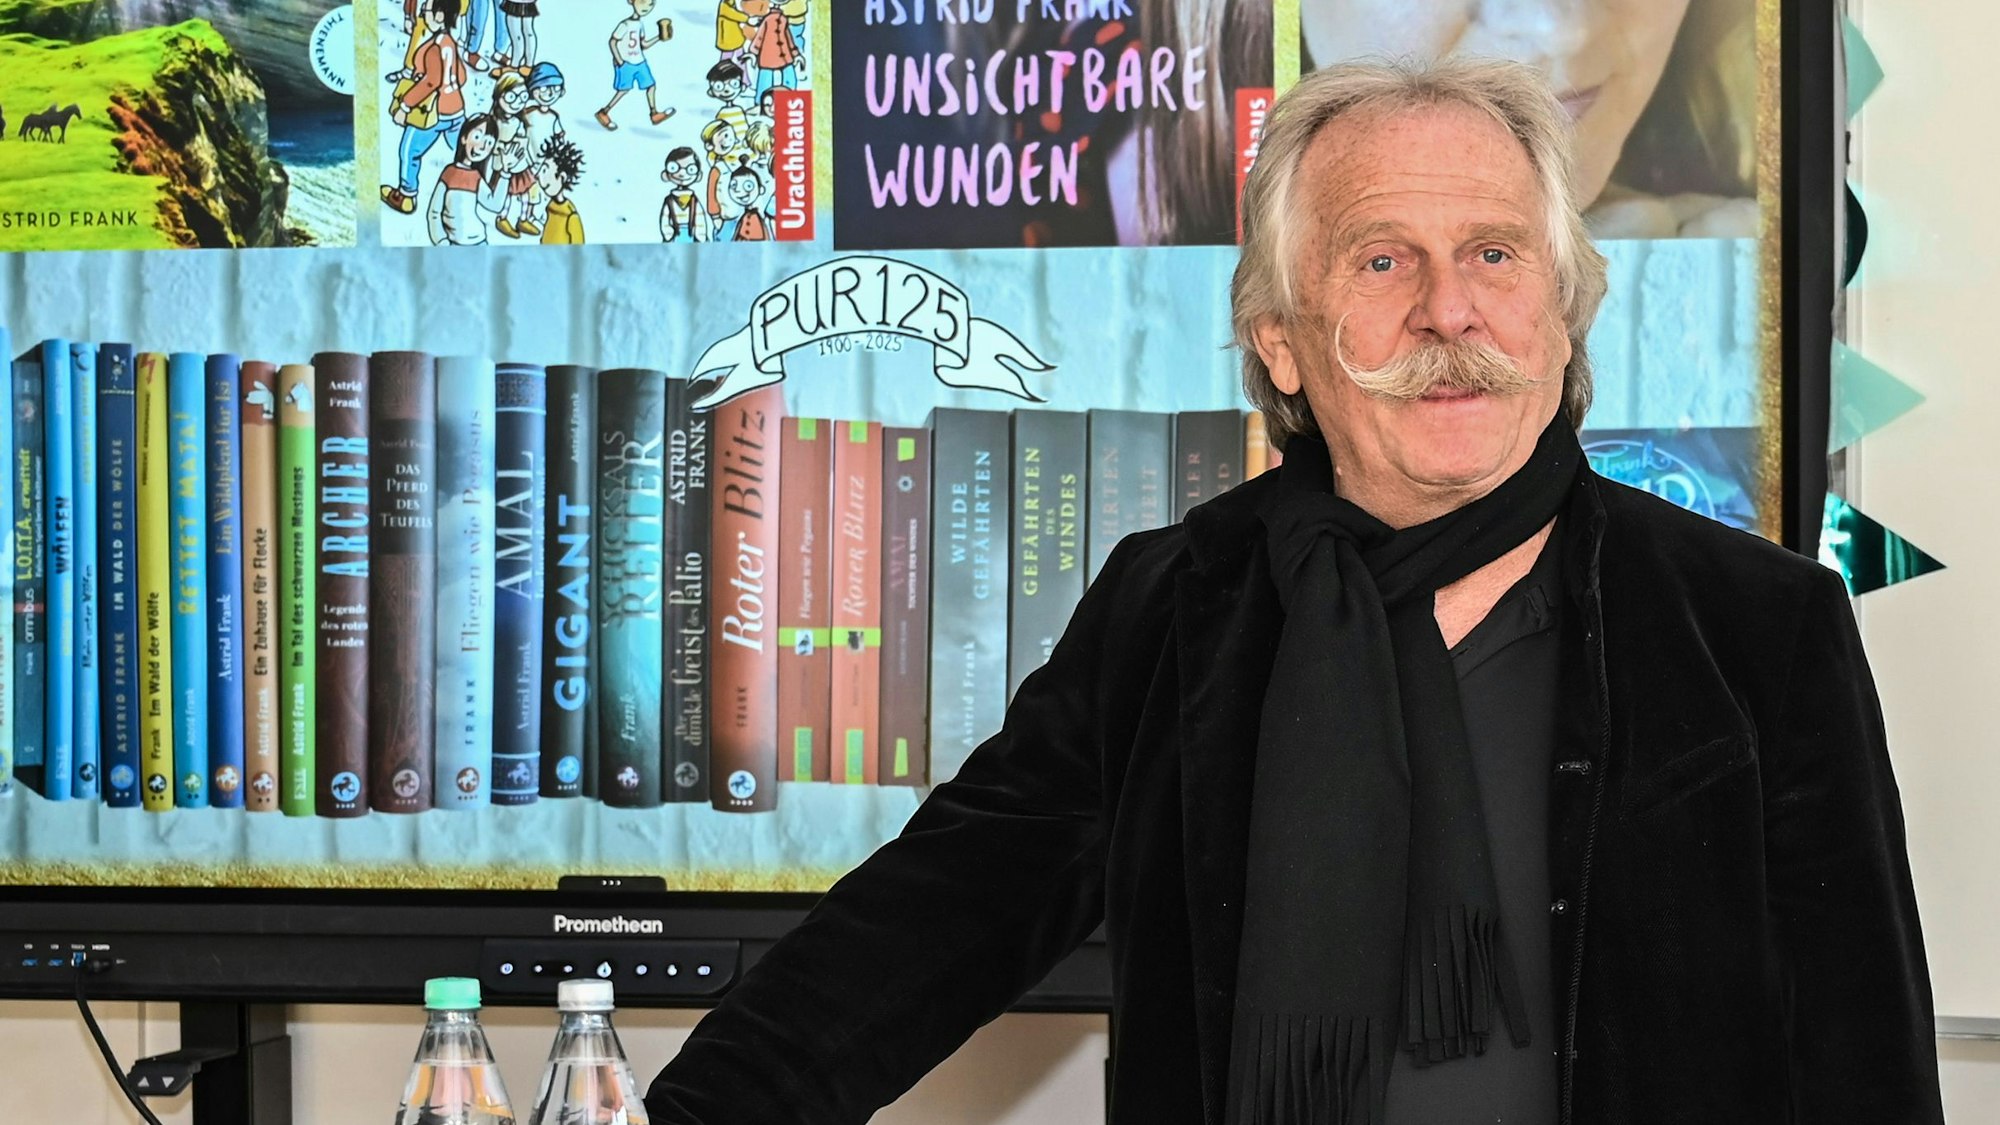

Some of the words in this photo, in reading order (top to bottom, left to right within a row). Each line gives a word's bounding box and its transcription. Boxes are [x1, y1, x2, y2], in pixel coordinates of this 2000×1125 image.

[315, 13, 346, 88] THIENEMANN
[782, 97, 806, 229] Urachhaus
[865, 141, 1079, 209] WUNDEN
[1, 212, 61, 230] STRID
[70, 210, 138, 228] FRANK
[819, 335, 852, 356] 1900
[865, 333, 902, 352] 2025
[329, 381, 363, 391] Astrid
[330, 398, 361, 409] Frank
[571, 392, 580, 425] Frank
[111, 439, 122, 492] WÖLFE
[463, 410, 483, 505] Pegasus
[571, 428, 580, 463] Astrid
[669, 429, 687, 505] ASTRID
[690, 418, 706, 488] FRANK
[723, 408, 765, 520] Blitz
[214, 440, 234, 522] Wildpferd
[395, 464, 420, 474] DAS
[112, 501, 122, 531] DER
[291, 467, 305, 528] Mustangs
[322, 435, 369, 577] ARCHER
[396, 499, 420, 510] DES
[52, 496, 70, 574] WÖLFEN
[216, 525, 232, 554] Ein
[463, 516, 482, 555] wie
[496, 450, 534, 600] AMAL
[621, 432, 662, 622] REITER
[951, 482, 968, 564] WILDE
[973, 449, 991, 600] GEFÄHRTEN
[1022, 446, 1040, 596] GEFÄHRTEN
[1045, 508, 1055, 535] DES
[1059, 472, 1077, 571] WINDES
[113, 539, 124, 584] WALD
[177, 515, 198, 615] RETTET
[253, 527, 267, 568] Flocke
[291, 532, 304, 599] schwarzen
[252, 574, 267, 595] für
[668, 551, 703, 606] Palio
[721, 530, 765, 655] Roter
[25, 587, 35, 643] omnibus
[114, 592, 124, 611] IM
[146, 592, 159, 631] Wölfe
[216, 594, 232, 633] Frank
[291, 603, 303, 625] des
[324, 603, 367, 616] Legende
[461, 566, 482, 653] Fliegen
[553, 494, 590, 711] GIGANT
[147, 635, 160, 657] der
[253, 599, 267, 650] Zuhause
[291, 629, 303, 646] Tal
[320, 620, 339, 630] des
[327, 637, 365, 647] Landes
[114, 631, 125, 685] FRANK
[147, 661, 160, 694] Wald
[217, 637, 232, 682] Astrid
[254, 656, 268, 676] Ein
[292, 651, 303, 667] Im
[517, 641, 531, 684] Frank
[669, 625, 706, 685] Geist
[962, 640, 975, 688] Frank
[149, 698, 161, 717] Im
[292, 682, 304, 717] Frank
[464, 680, 475, 745] FRANK
[517, 687, 531, 732] Astrid
[620, 692, 637, 742] Frank
[736, 686, 748, 728] FRANK
[962, 695, 975, 748] Astrid
[115, 693, 127, 752] ASTRID
[150, 728, 161, 760] Frank
[292, 721, 304, 756] Astrid
[554, 914, 664, 933] Promethean
